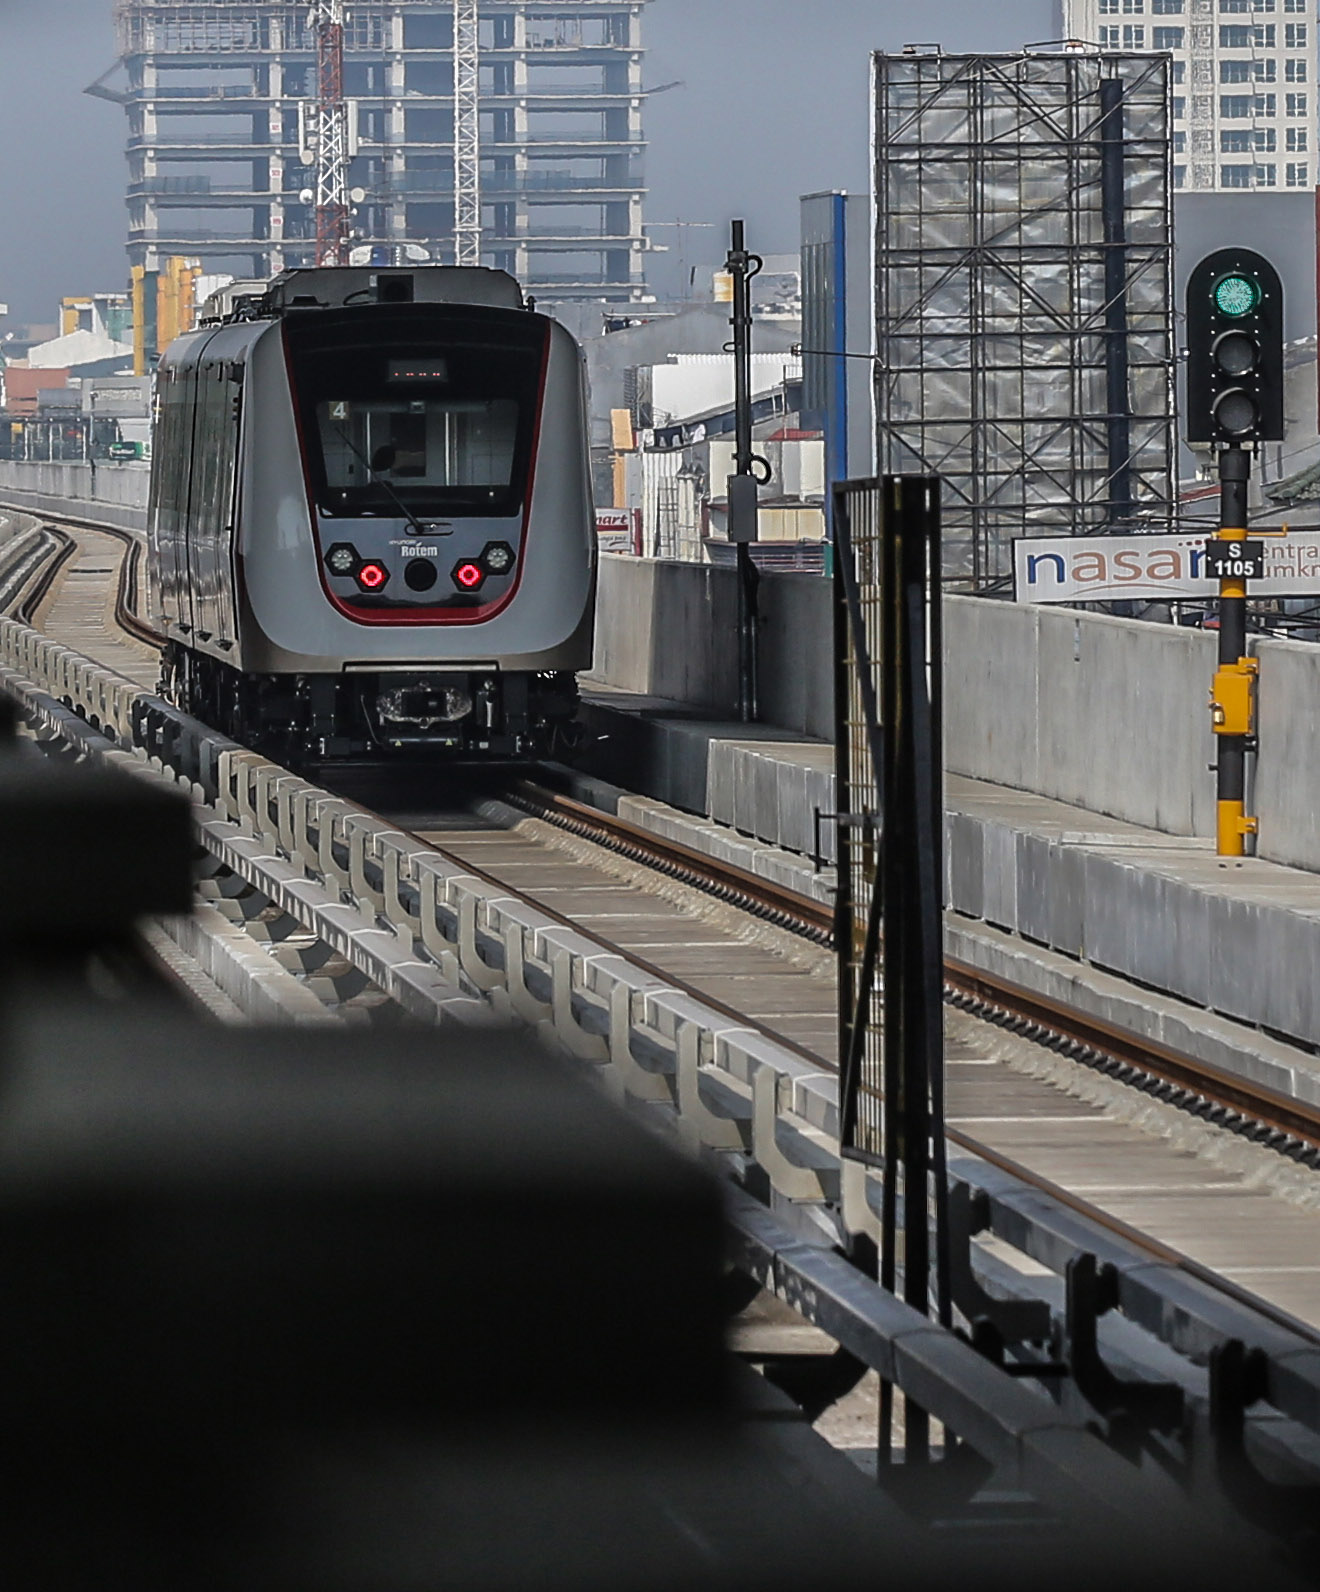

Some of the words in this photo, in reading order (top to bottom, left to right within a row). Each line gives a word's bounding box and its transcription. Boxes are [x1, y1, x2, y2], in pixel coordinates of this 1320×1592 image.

[333, 401, 346, 419] 4
[401, 542, 438, 557] Rotem
[1229, 543, 1242, 558] S
[1263, 544, 1318, 559] entra
[1214, 560, 1255, 576] 1105
